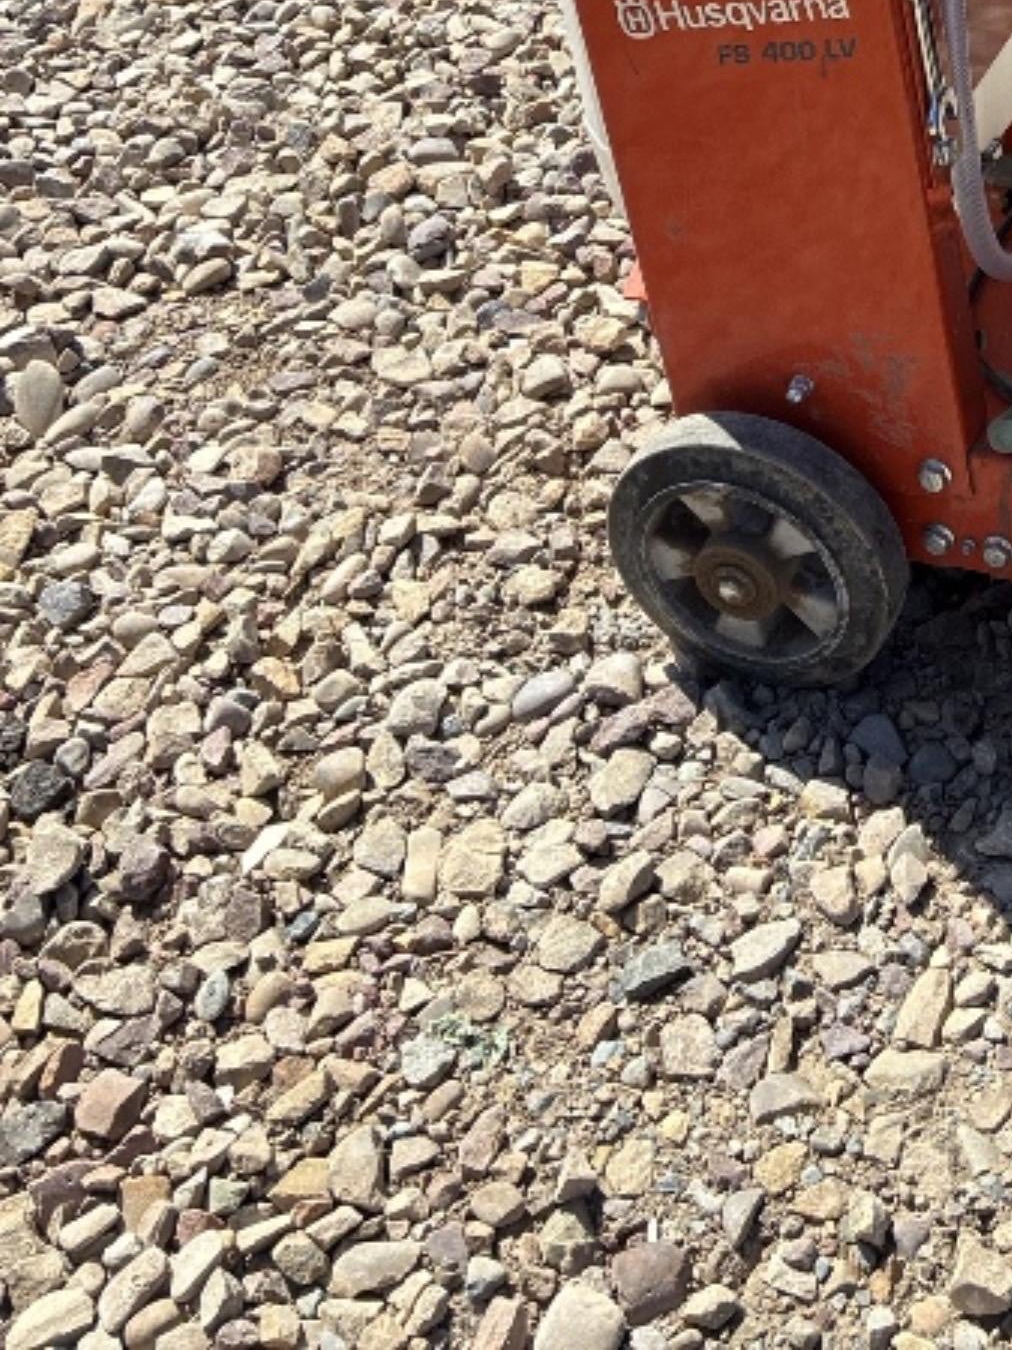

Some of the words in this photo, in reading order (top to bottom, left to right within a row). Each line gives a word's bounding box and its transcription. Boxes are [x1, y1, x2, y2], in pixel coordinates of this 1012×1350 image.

[717, 43, 751, 66] FS
[762, 40, 816, 63] 400
[823, 36, 857, 59] LV
